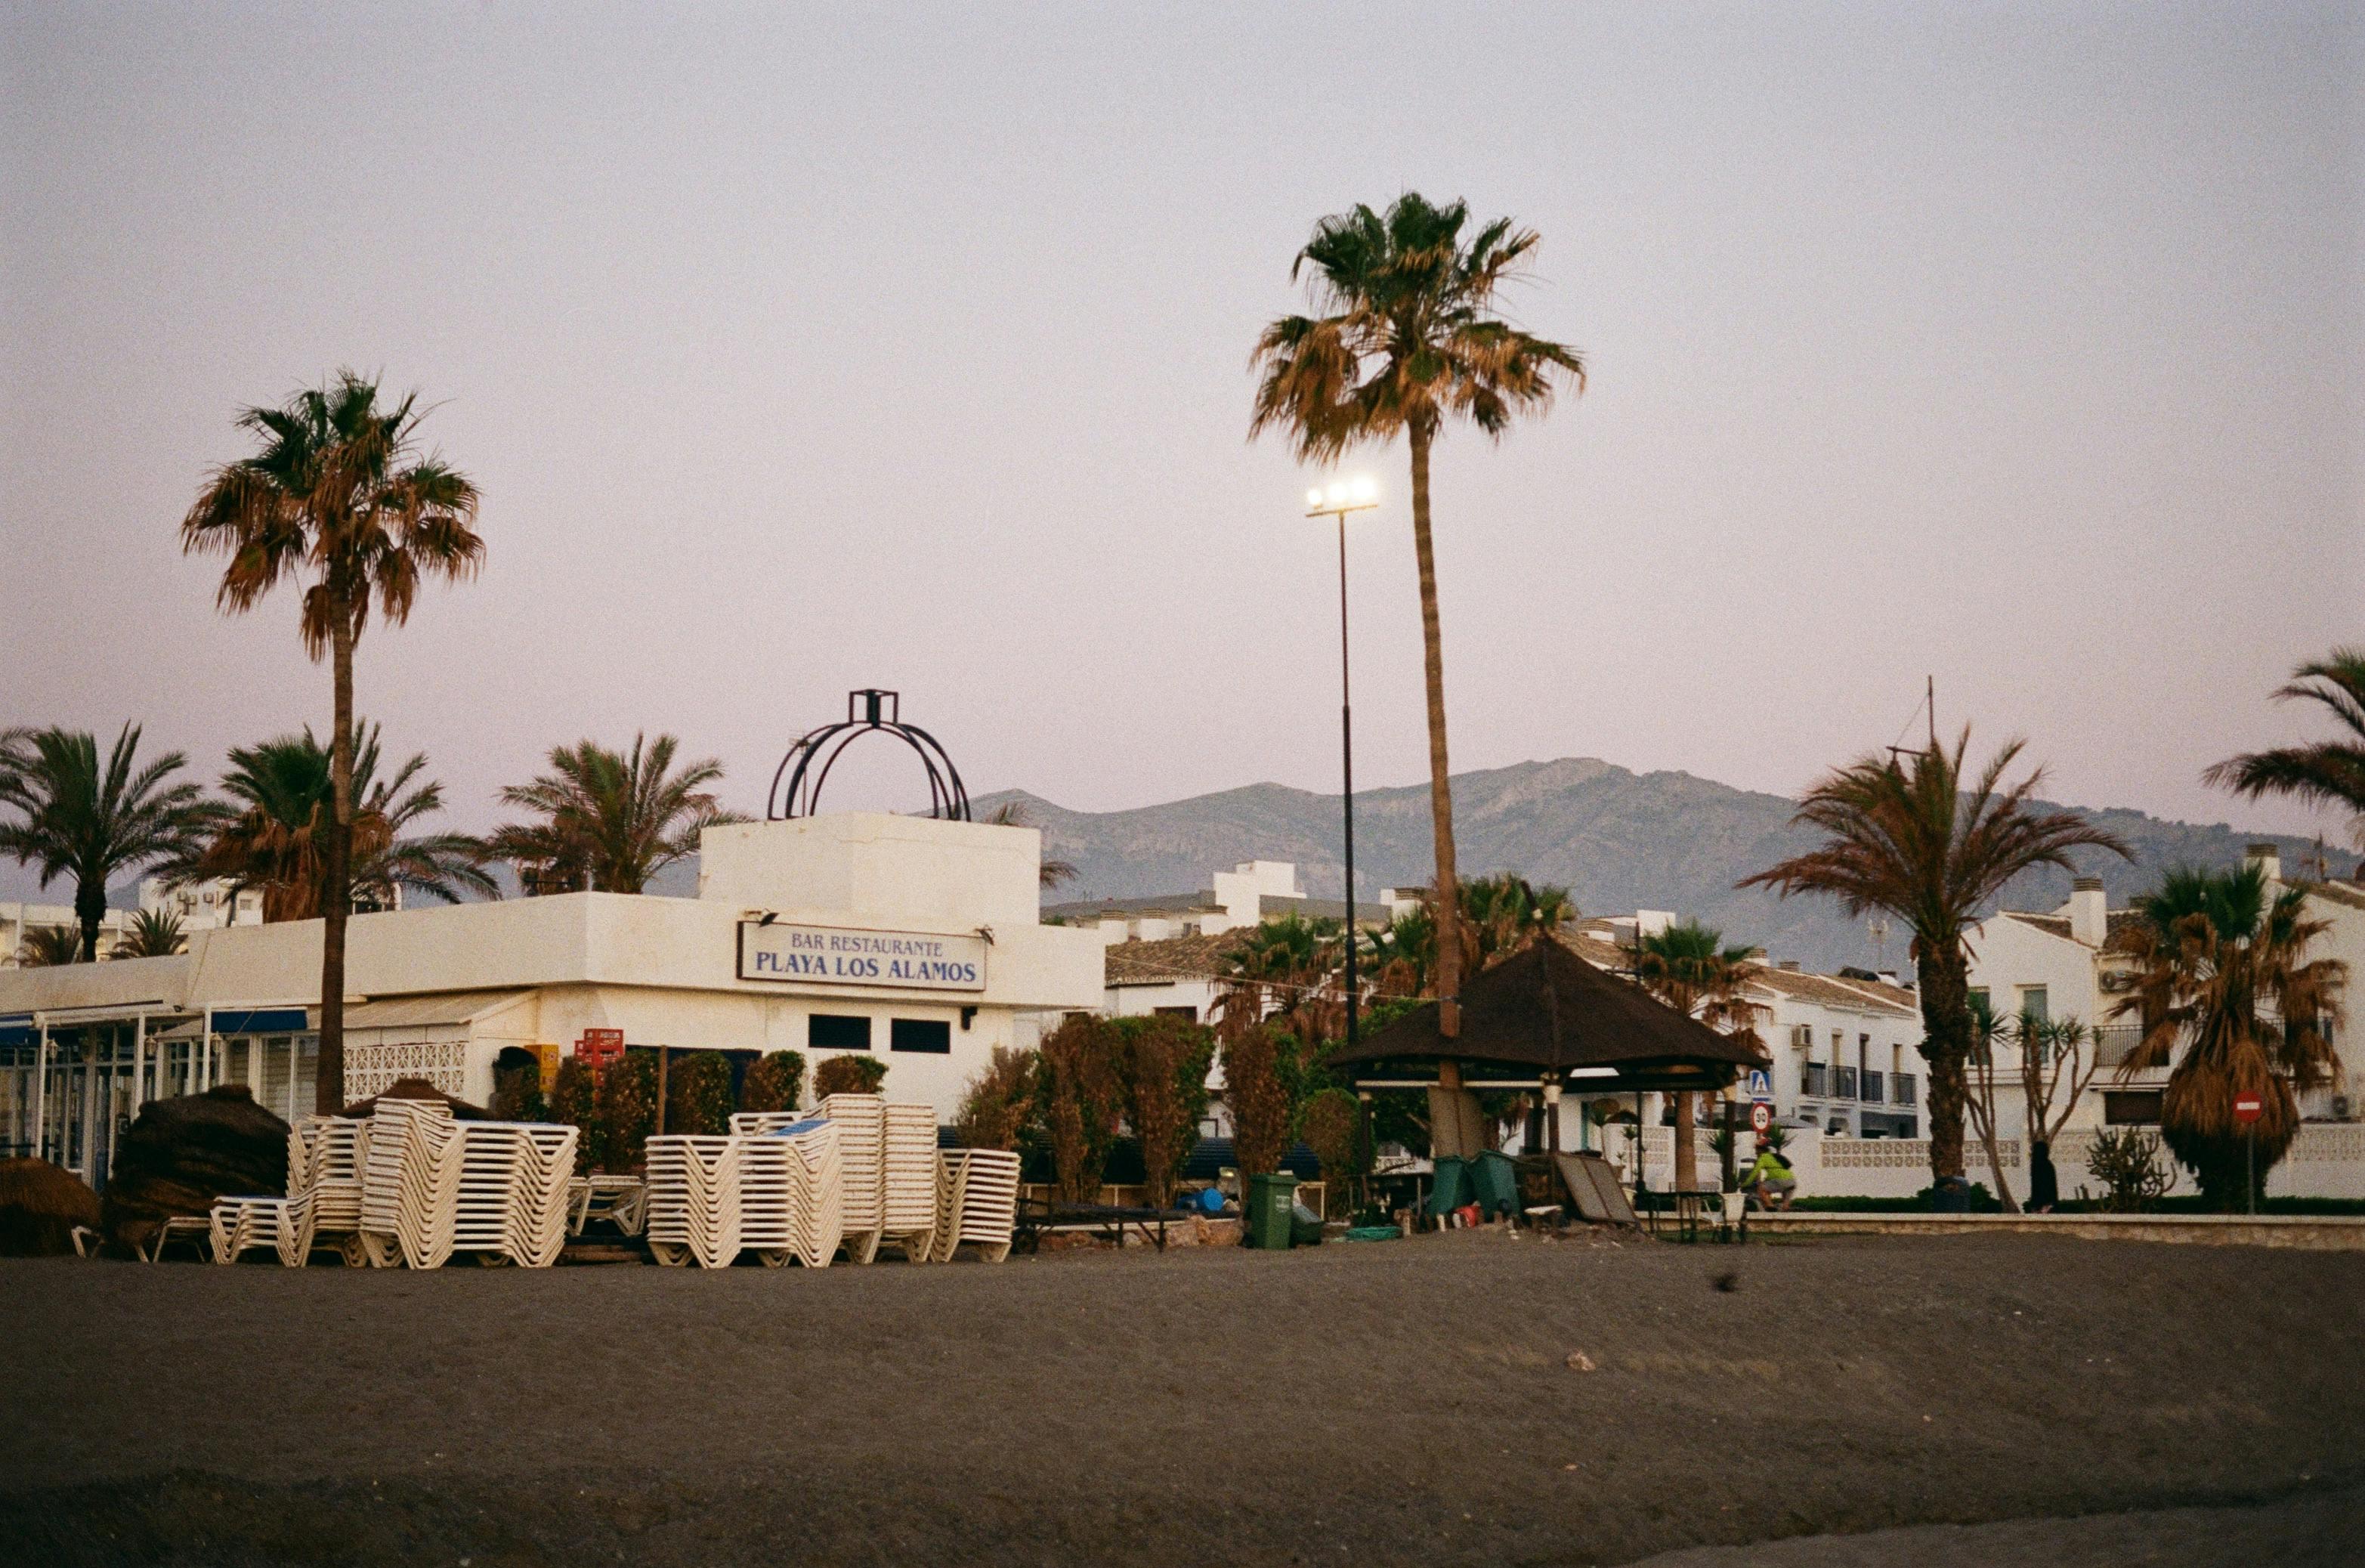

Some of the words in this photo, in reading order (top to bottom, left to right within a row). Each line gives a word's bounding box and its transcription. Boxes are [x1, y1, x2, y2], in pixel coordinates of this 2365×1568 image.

[792, 932, 824, 950] BAR
[830, 936, 943, 957] RESTAURANTE
[756, 951, 827, 975] PLAYA
[836, 957, 879, 977] LOS
[888, 960, 976, 982] ALAMOS
